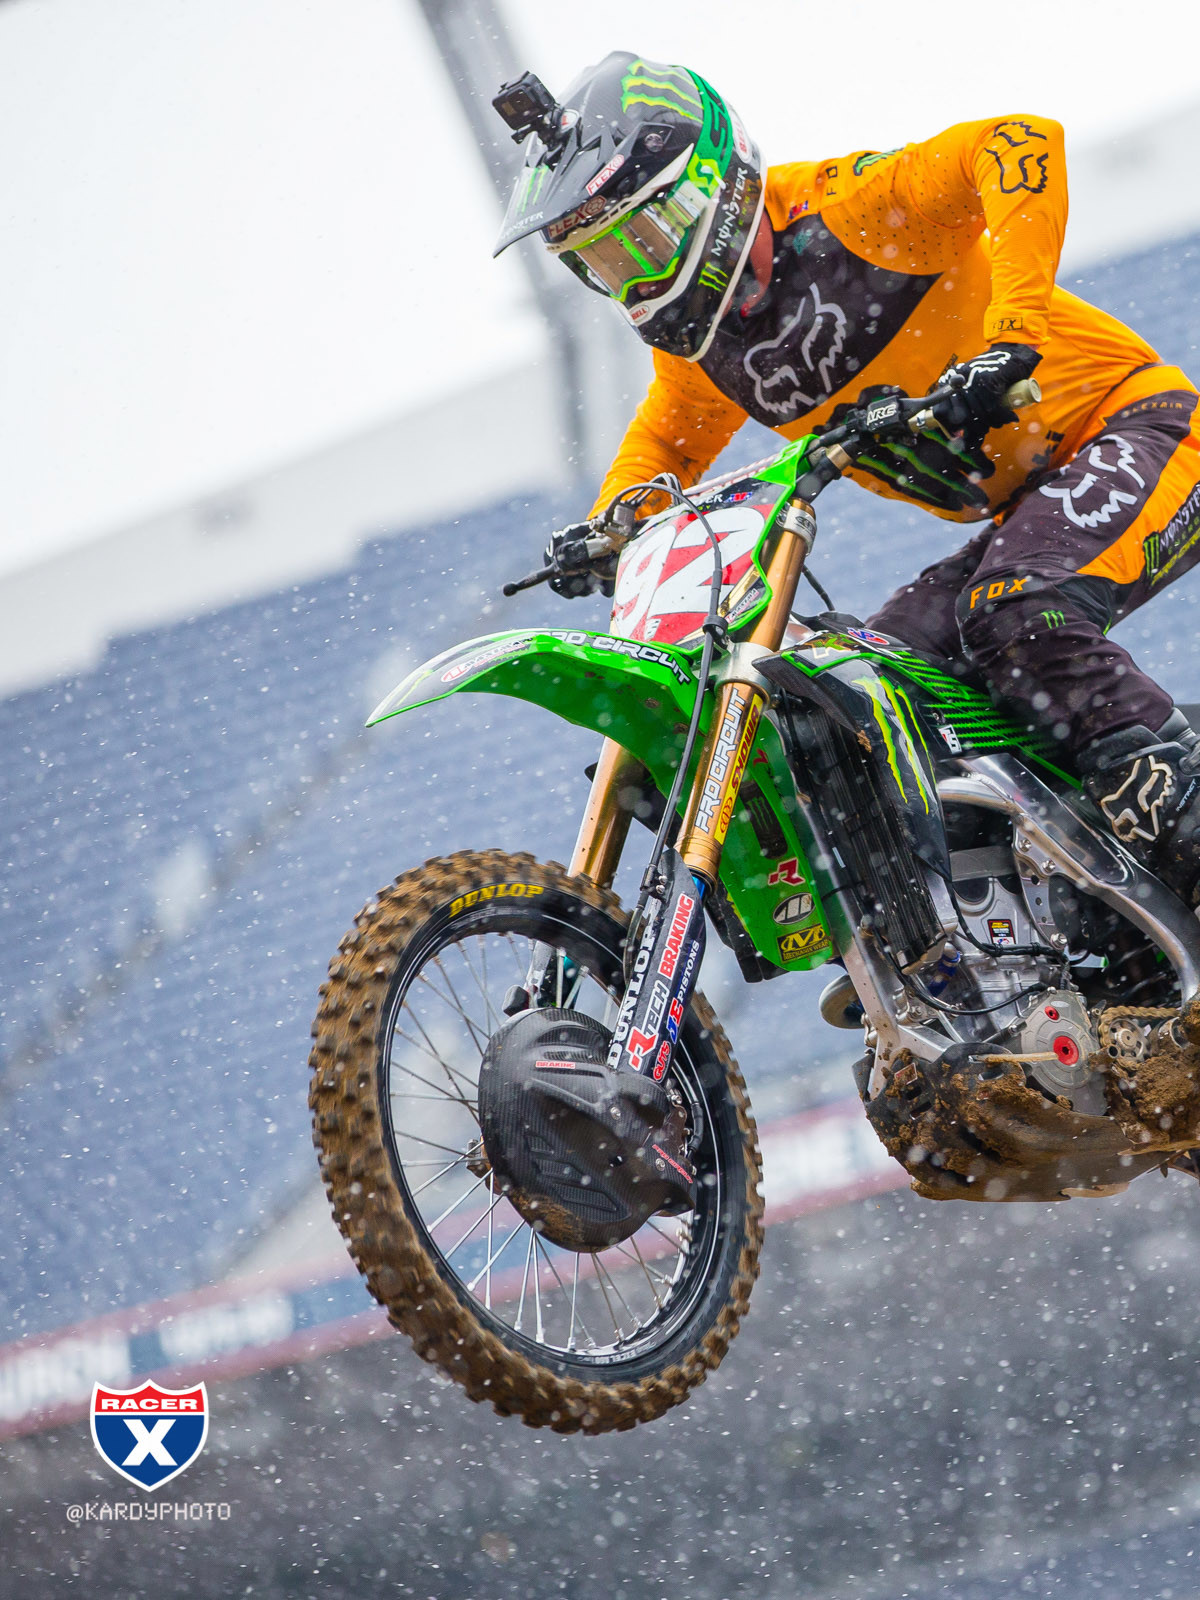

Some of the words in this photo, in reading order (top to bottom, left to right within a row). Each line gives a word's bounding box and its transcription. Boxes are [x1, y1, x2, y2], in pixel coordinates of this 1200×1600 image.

[631, 307, 648, 321] BELL
[866, 402, 898, 427] ARC
[613, 506, 766, 640] 92
[969, 577, 1028, 610] FOX
[592, 634, 692, 687] CIRCUIT
[708, 687, 746, 784] CIRCUIT
[731, 703, 760, 794] SHOWA
[695, 777, 722, 835] PRO
[448, 883, 546, 919] DUNLOP
[658, 893, 694, 981] BRAKING
[606, 925, 656, 1070] DUNLOP
[676, 939, 700, 1004] PISTONS
[536, 1061, 575, 1069] BRAKING
[653, 1040, 671, 1084] GUTS
